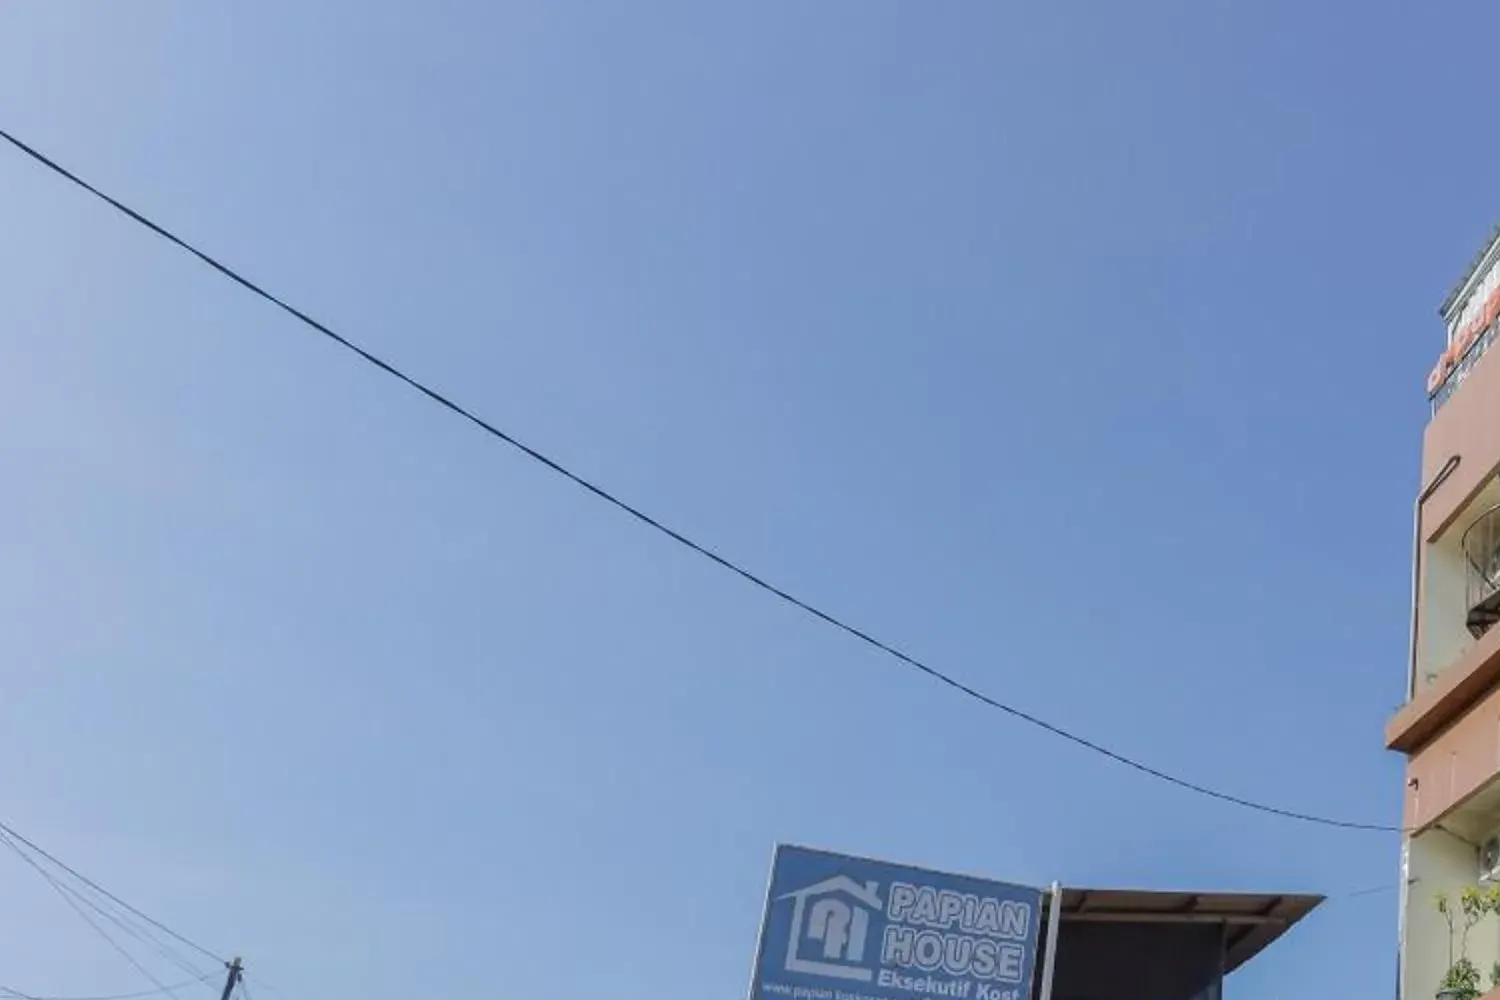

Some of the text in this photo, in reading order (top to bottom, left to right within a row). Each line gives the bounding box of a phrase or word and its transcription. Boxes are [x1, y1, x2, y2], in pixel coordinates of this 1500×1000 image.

[889, 883, 1030, 940] PAPIAN
[881, 925, 1024, 983] HOUSE
[877, 969, 971, 998] Eksekutif
